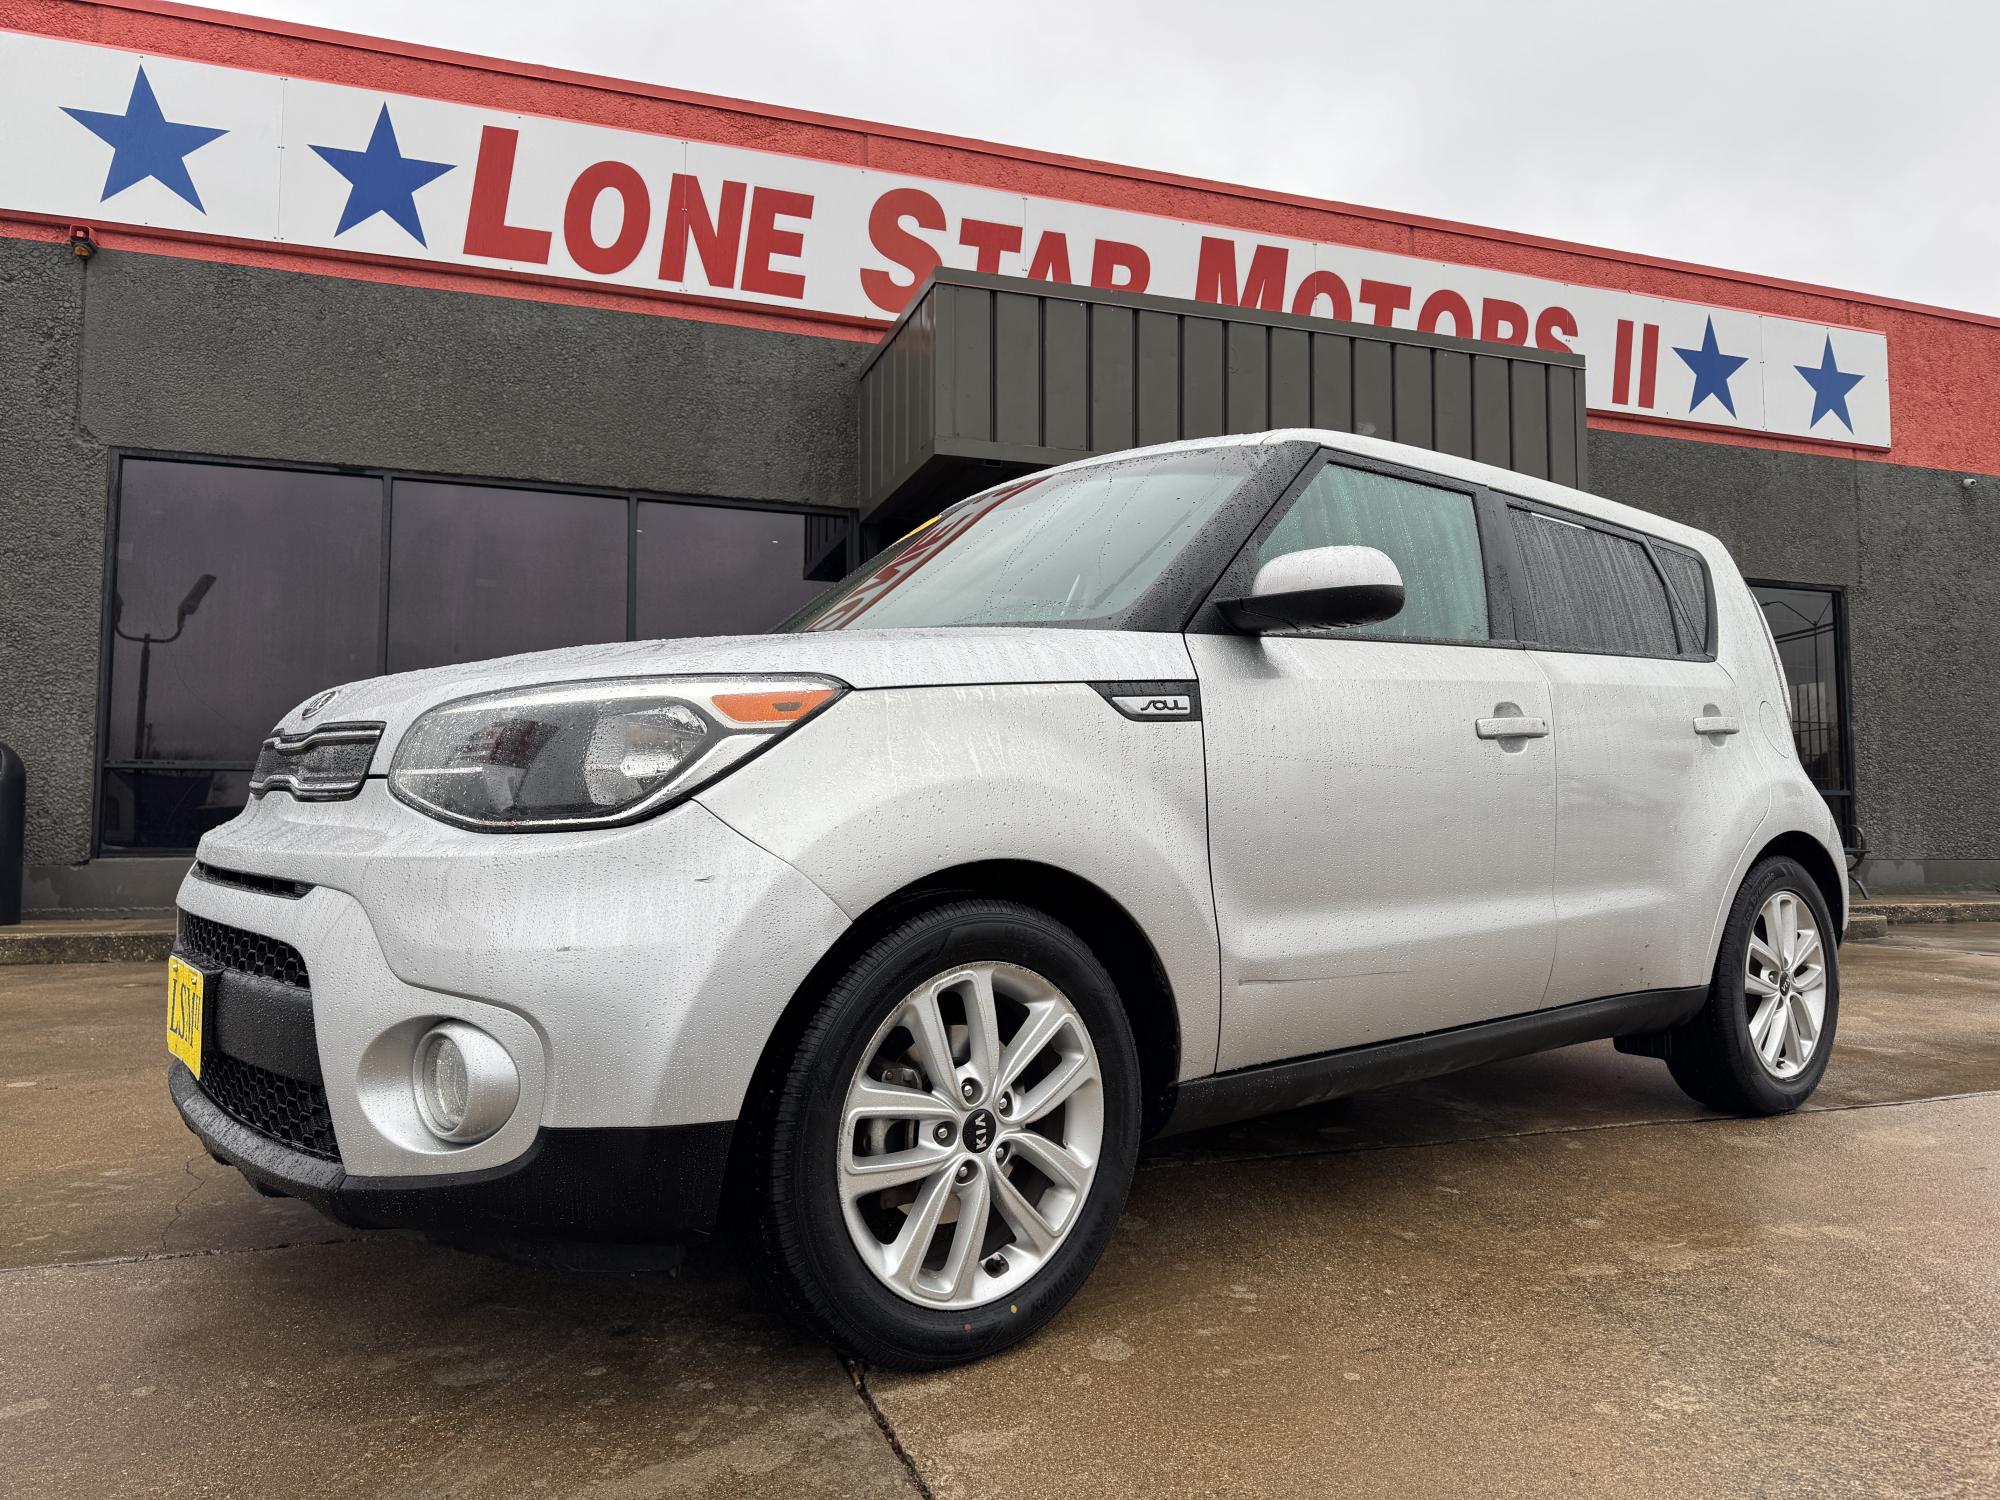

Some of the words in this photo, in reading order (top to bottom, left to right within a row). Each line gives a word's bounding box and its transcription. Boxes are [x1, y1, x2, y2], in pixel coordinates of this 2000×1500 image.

[462, 124, 815, 299] LONE
[860, 188, 1151, 314] STAR
[1612, 319, 1659, 409] II
[975, 1113, 987, 1150] KIA
